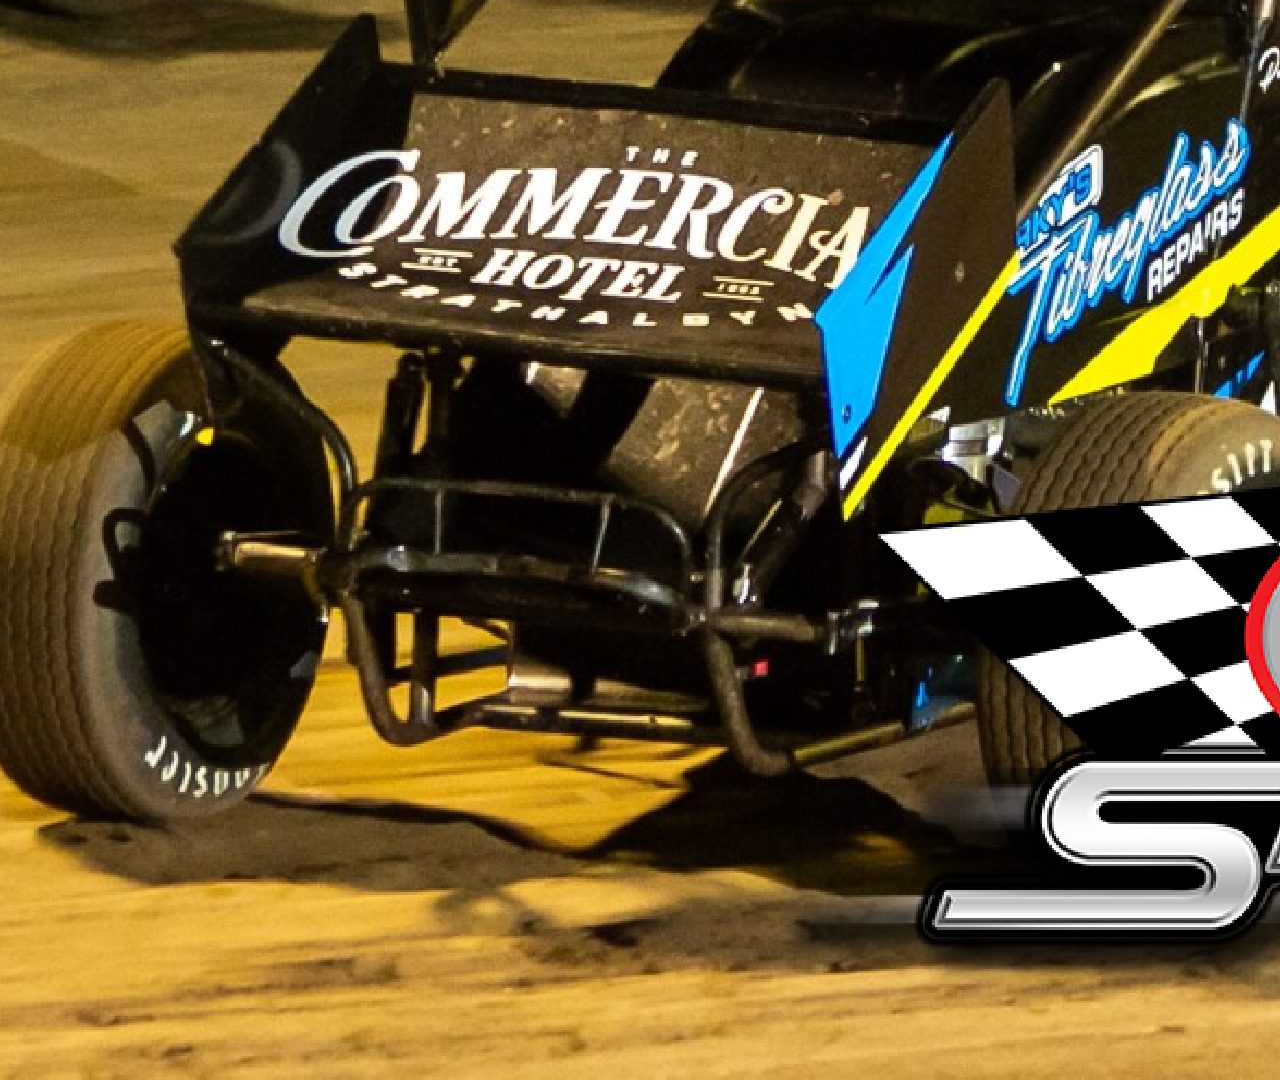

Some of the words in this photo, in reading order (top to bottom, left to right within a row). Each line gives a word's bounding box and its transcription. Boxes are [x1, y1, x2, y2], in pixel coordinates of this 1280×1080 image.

[625, 145, 700, 168] THE
[277, 148, 871, 289] COMMERCIA
[1147, 188, 1245, 303] REPAIRS
[469, 248, 687, 303] HOTEL
